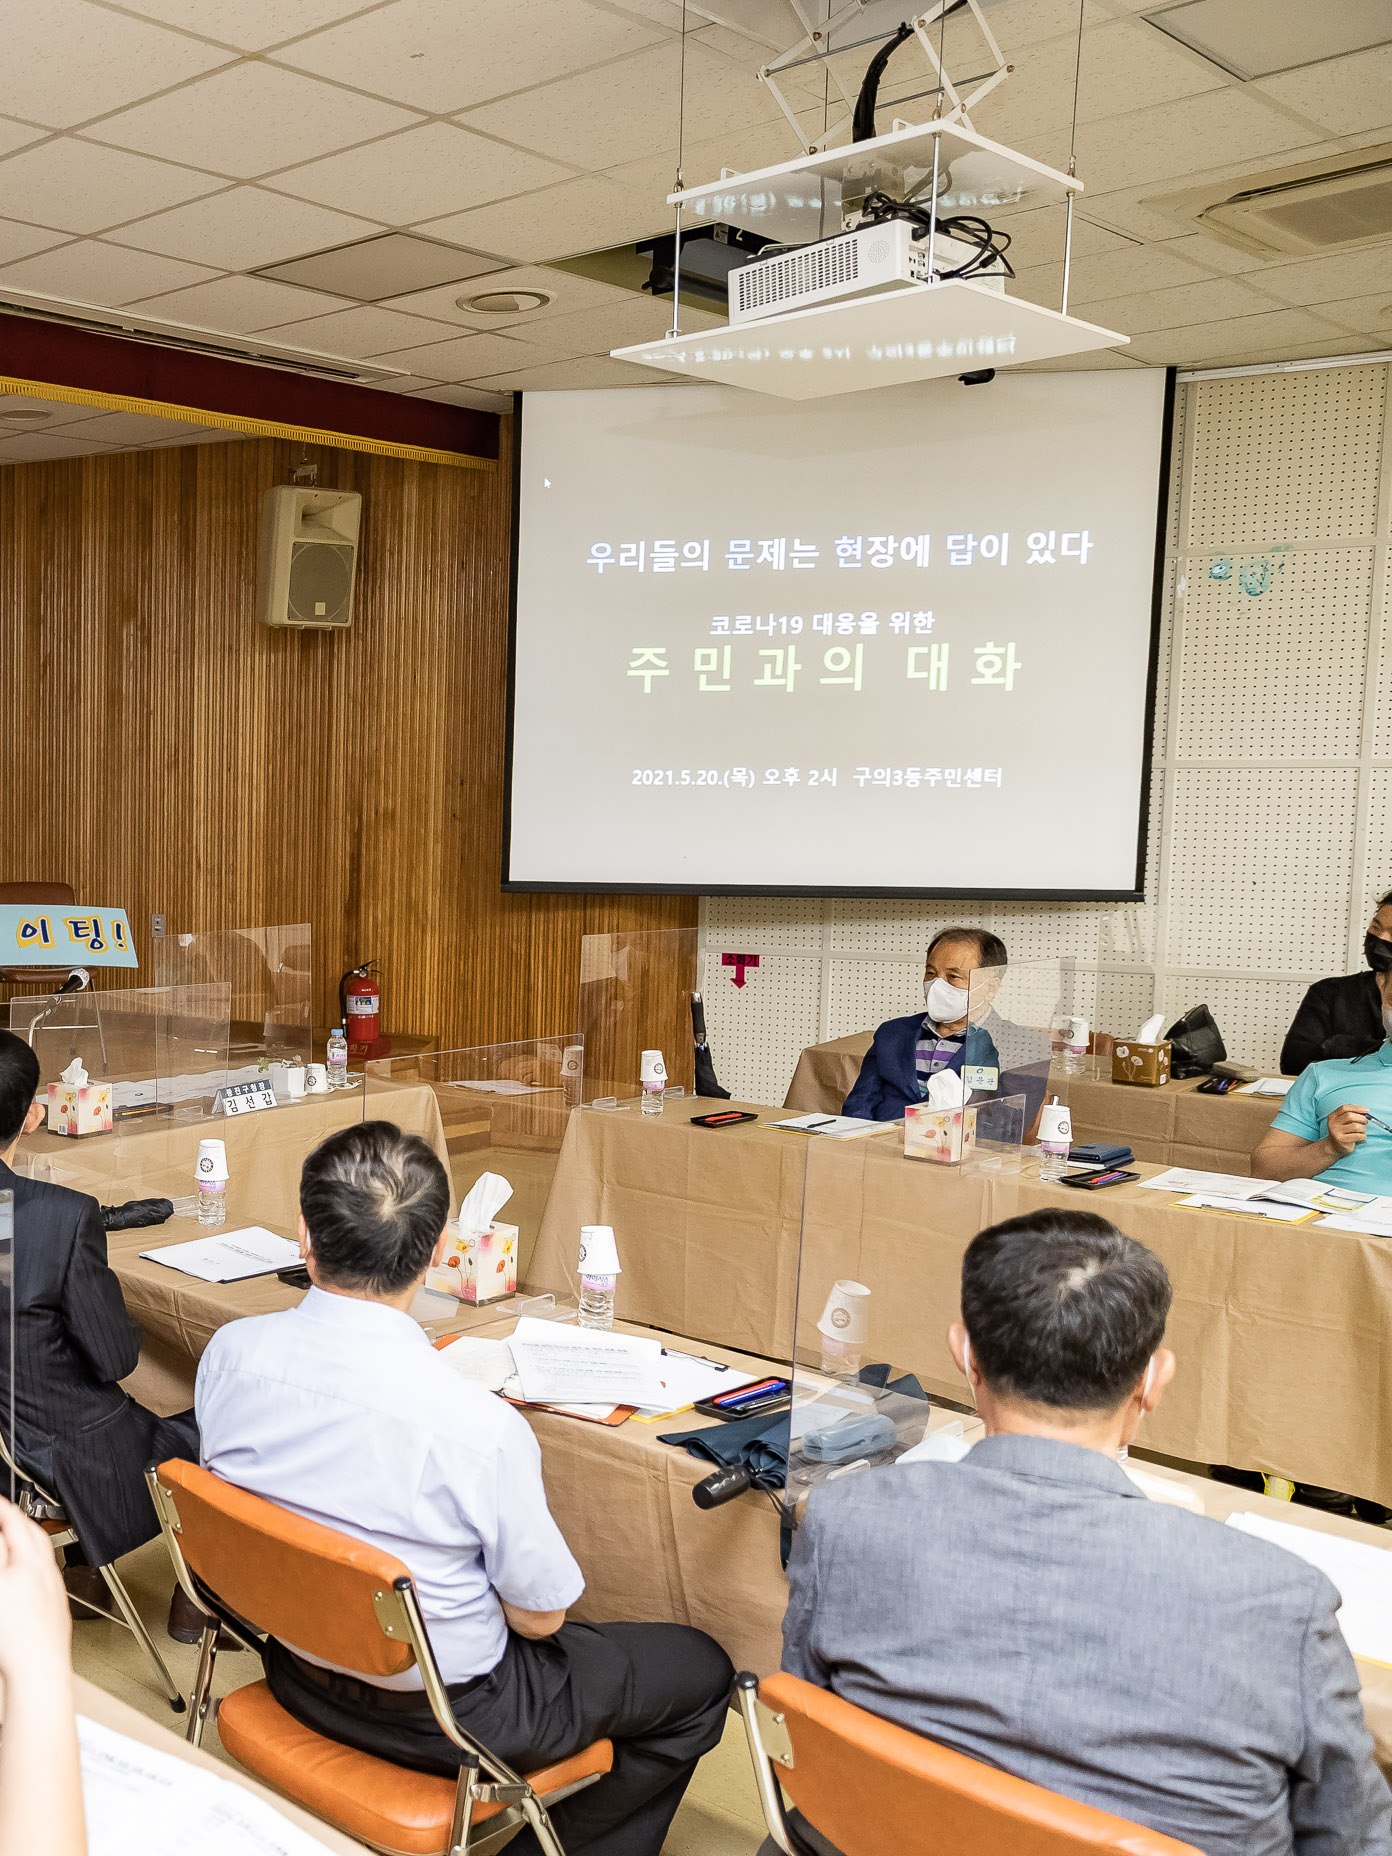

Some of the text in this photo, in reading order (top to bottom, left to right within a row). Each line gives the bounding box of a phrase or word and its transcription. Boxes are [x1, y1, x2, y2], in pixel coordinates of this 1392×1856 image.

[587, 531, 1093, 573] 우리들의 문제는 현장에 답이 있다
[710, 611, 935, 636] 코로나19 대응을 위한
[632, 768, 754, 788] 2021.5.20.(목)
[763, 767, 800, 787] 오후
[808, 768, 837, 787] 2시
[725, 954, 757, 967] 소화기
[226, 1081, 266, 1097] 광진구청장
[227, 1091, 273, 1112] 김선갑
